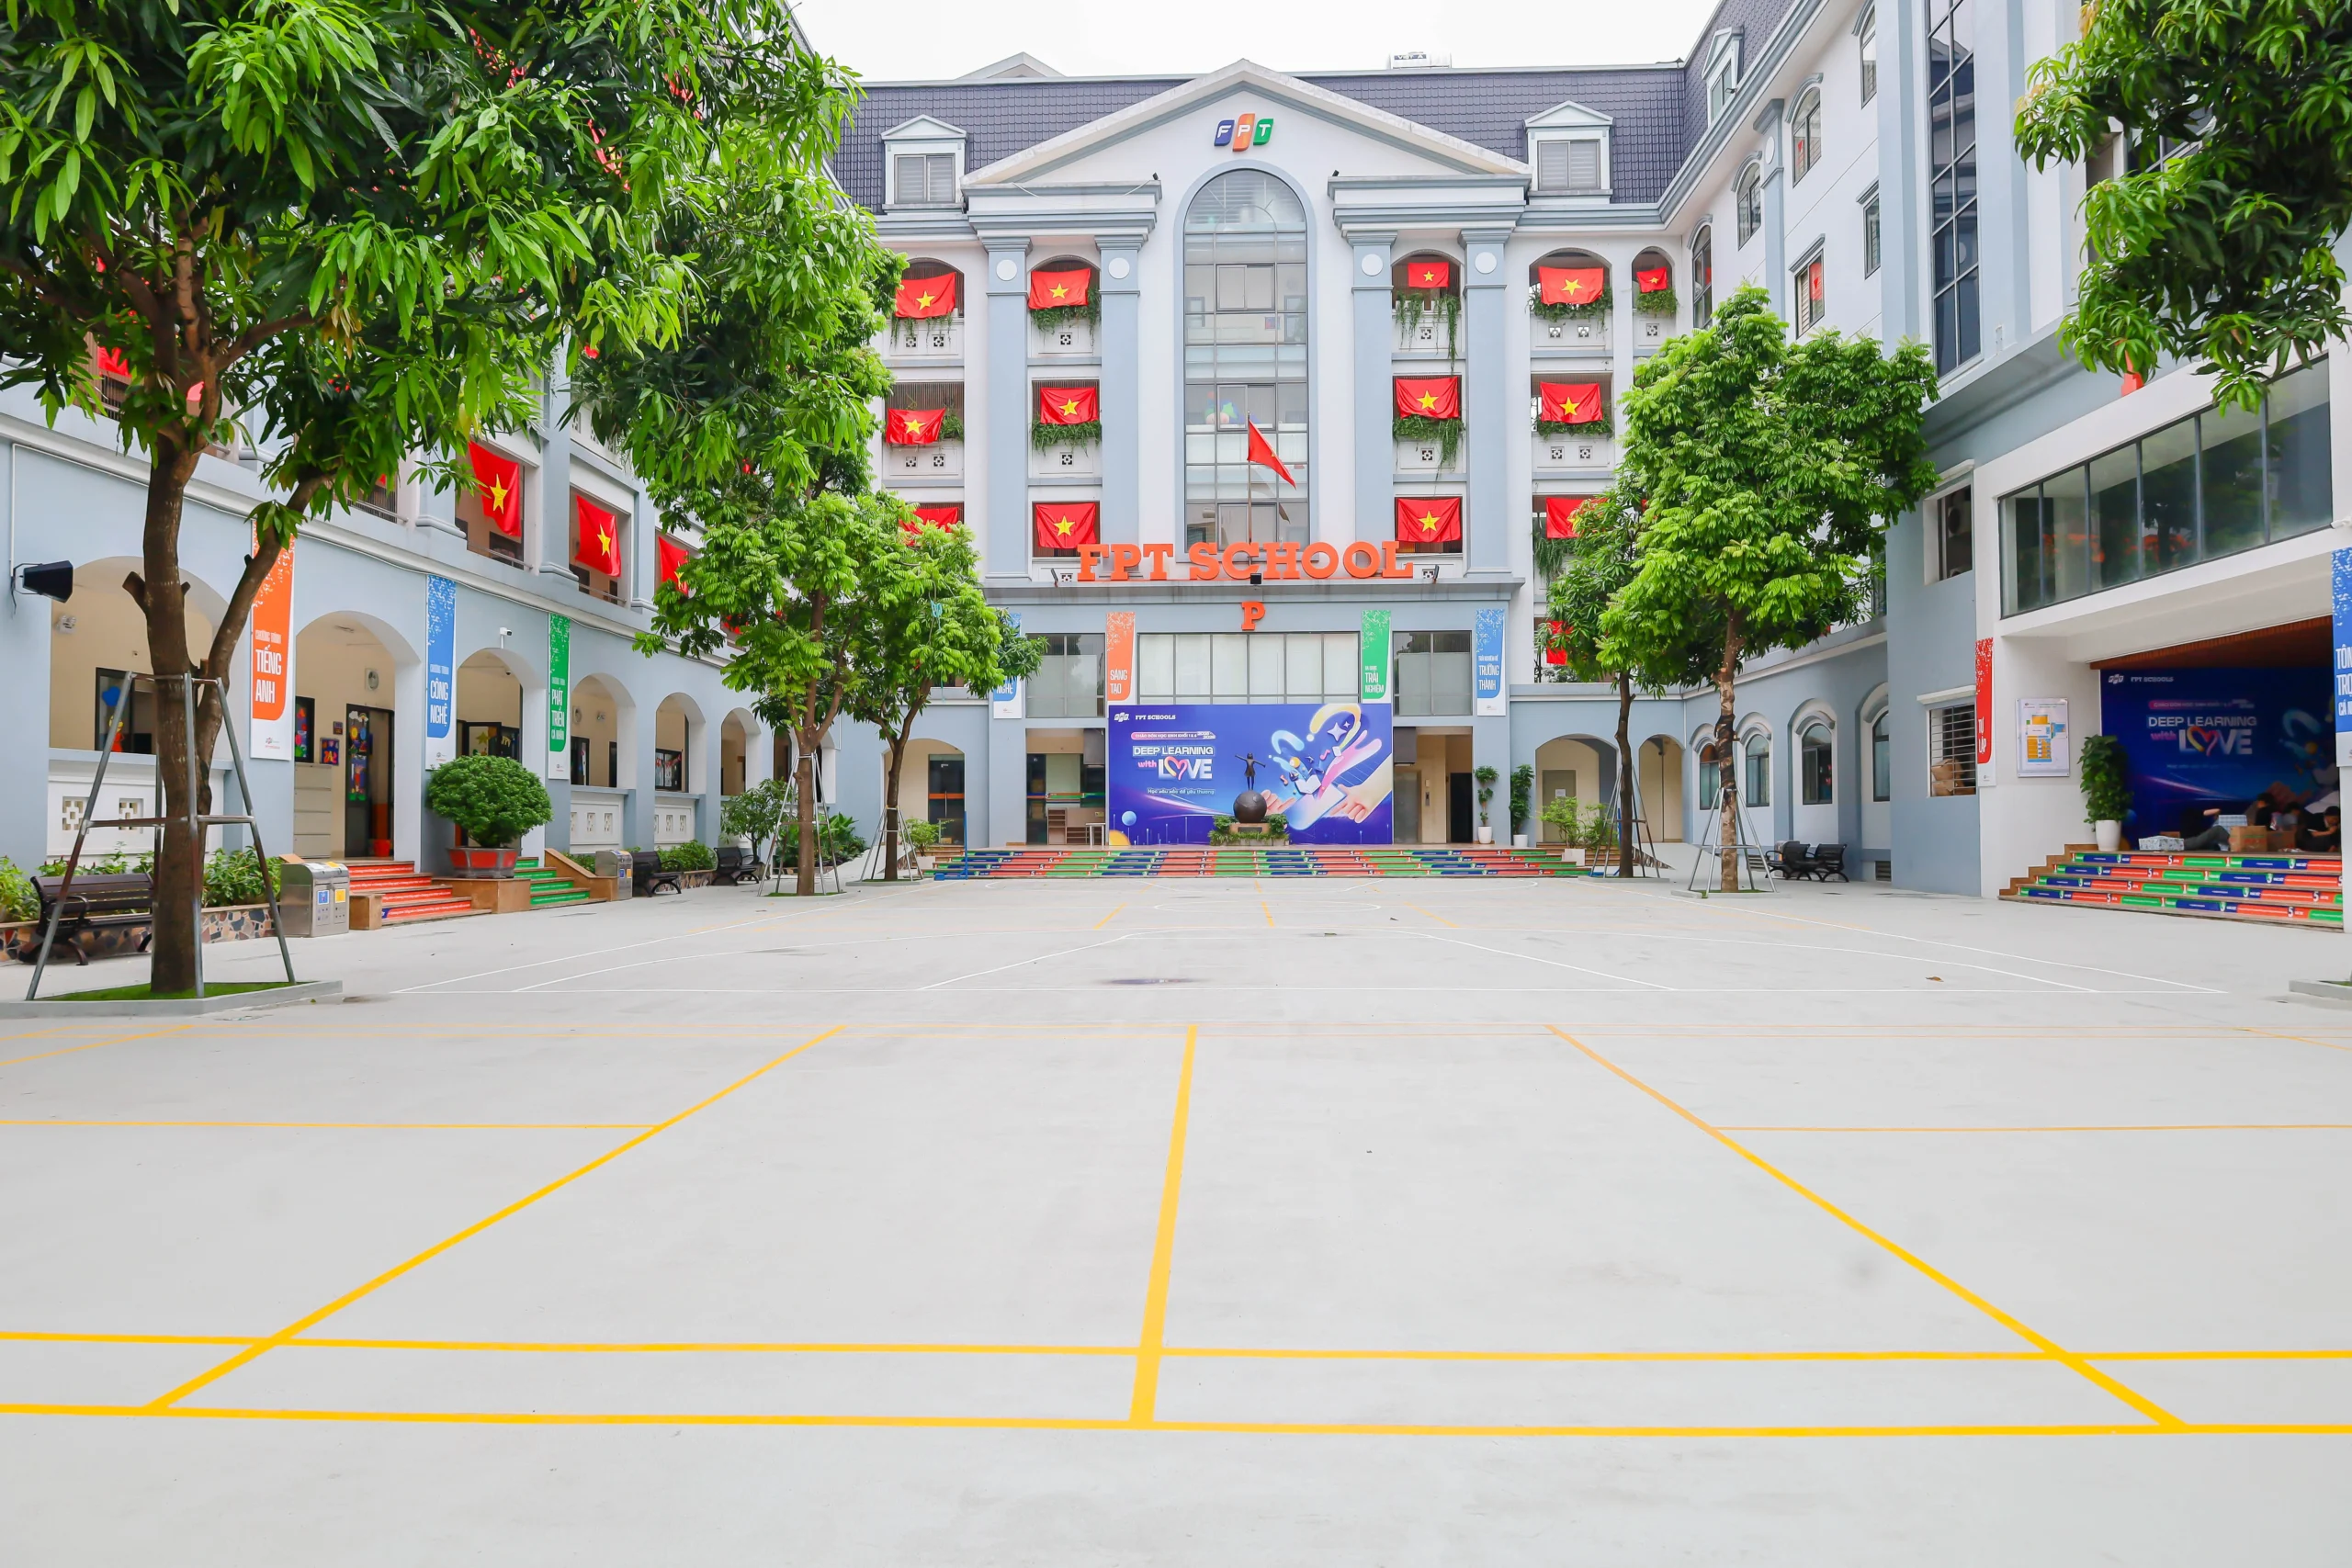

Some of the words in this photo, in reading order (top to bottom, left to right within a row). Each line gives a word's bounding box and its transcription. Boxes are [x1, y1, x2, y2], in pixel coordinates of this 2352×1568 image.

[1078, 543, 1174, 581] FPT
[1189, 541, 1414, 581] SCHOOL
[1241, 601, 1265, 631] P
[255, 644, 282, 675] TIẾNG
[1110, 667, 1128, 680] SÁNG
[255, 679, 275, 704] ANH
[430, 677, 448, 700] CÔNG
[430, 703, 448, 727] NGHỆ
[2148, 716, 2184, 727] DEEP
[2187, 716, 2257, 727] LEARNING
[2150, 731, 2177, 741] with
[1134, 746, 1161, 755] DEEP
[1162, 746, 1213, 755] LEARNING
